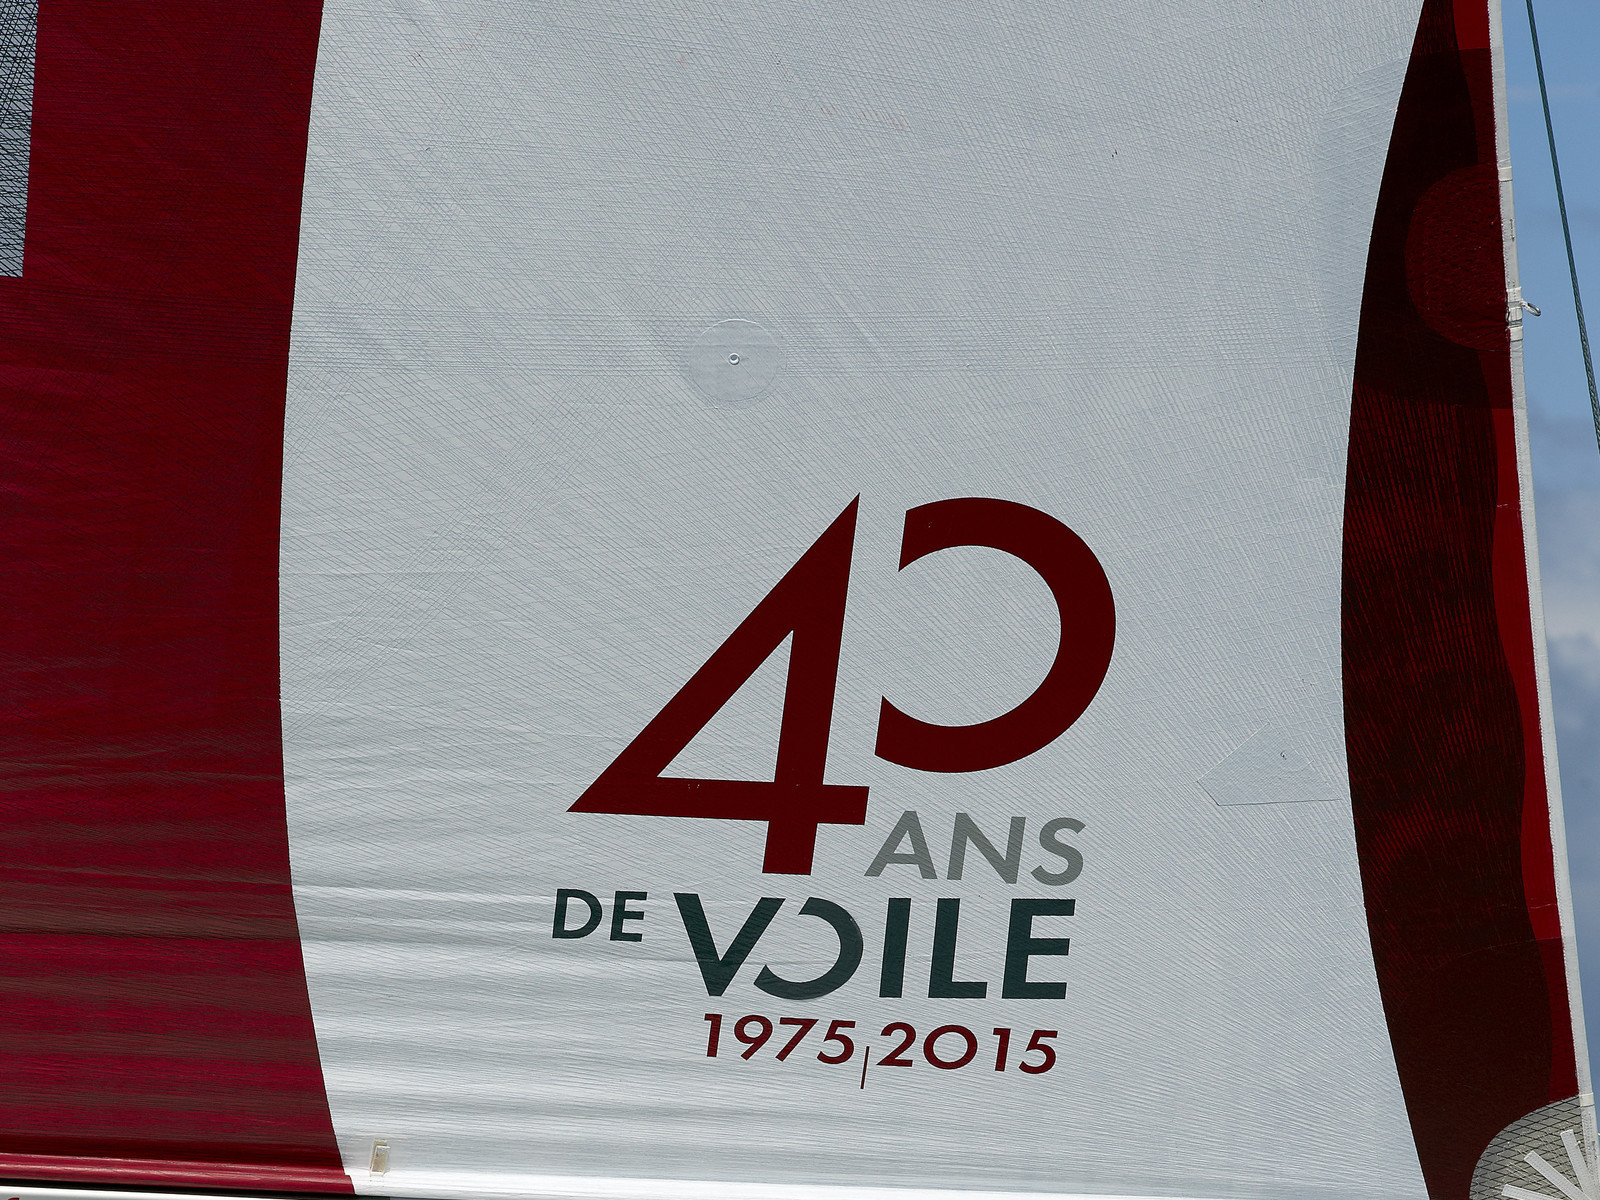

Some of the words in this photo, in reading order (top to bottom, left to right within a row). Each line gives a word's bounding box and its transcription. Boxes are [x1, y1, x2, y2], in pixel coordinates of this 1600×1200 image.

[566, 492, 1117, 876] 40
[864, 809, 1087, 887] ANS
[552, 888, 648, 943] DE
[673, 892, 1077, 1001] VOILE
